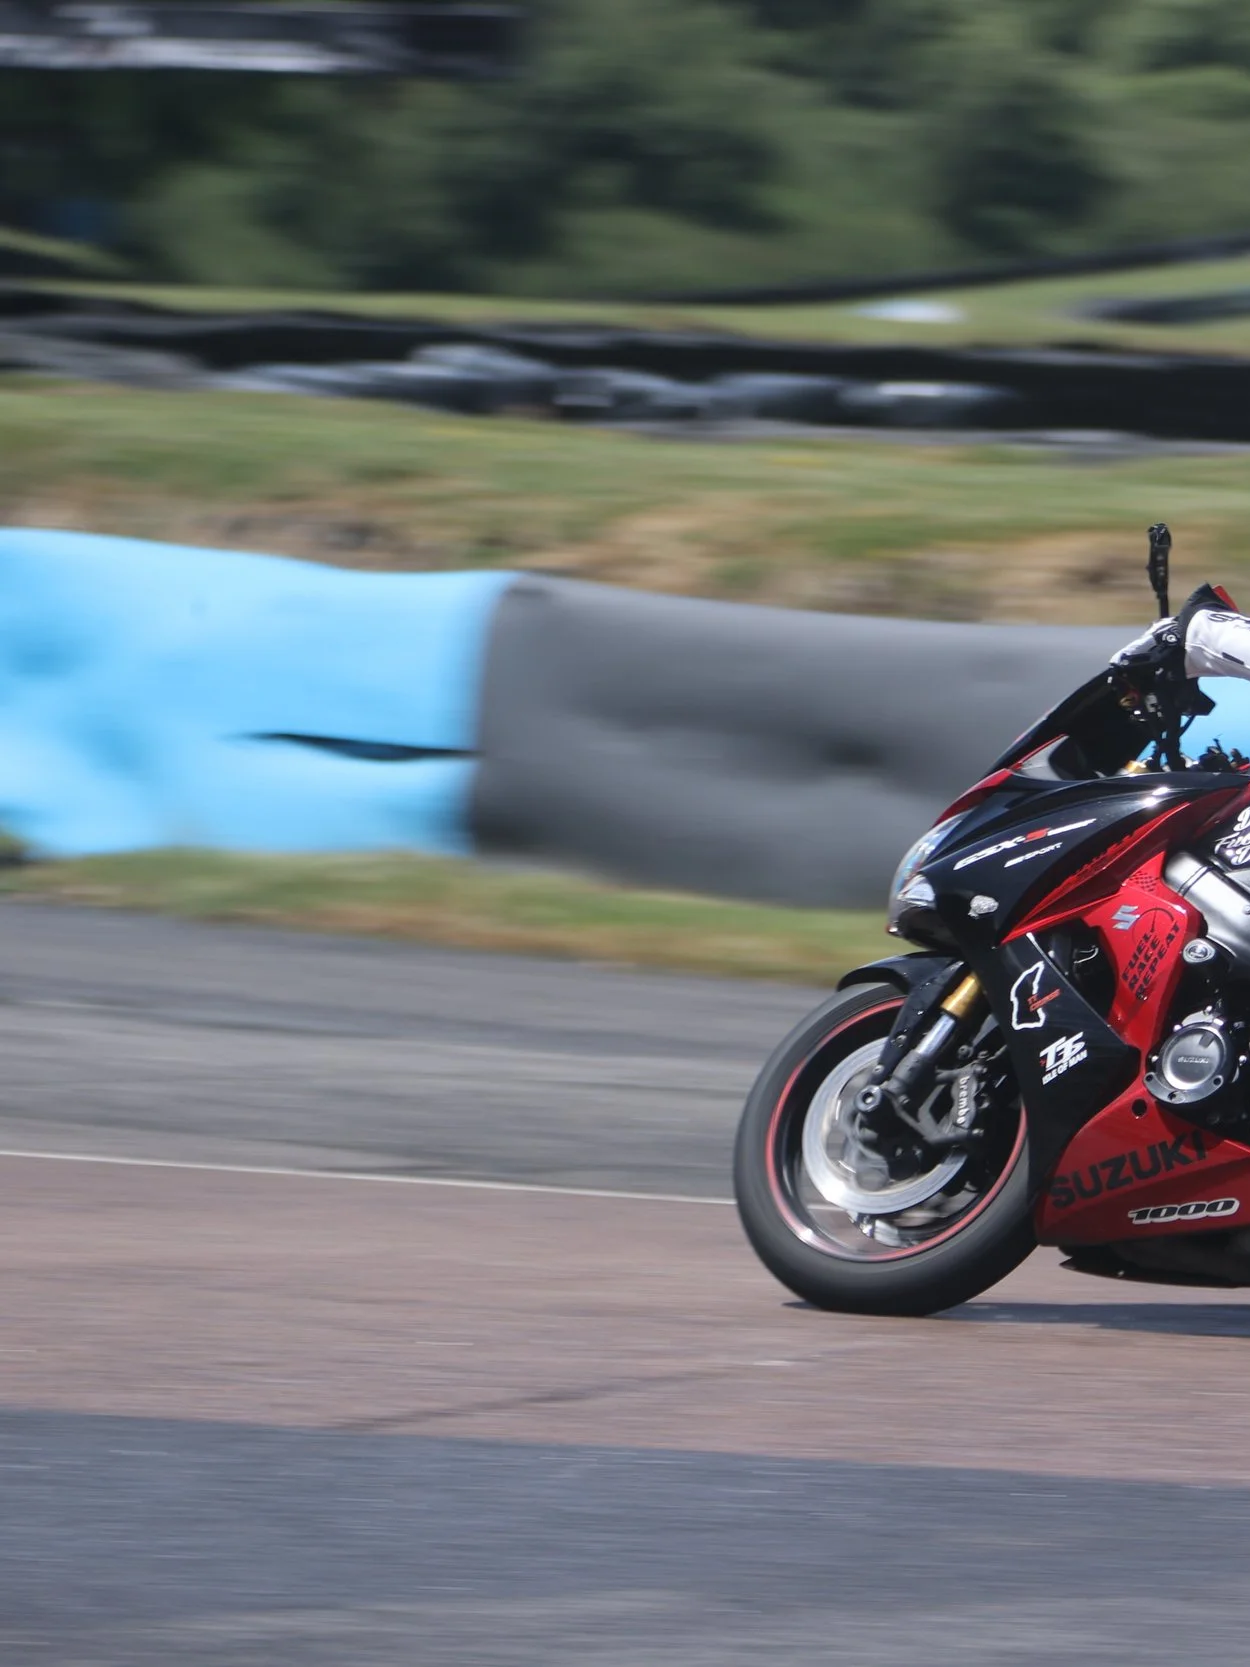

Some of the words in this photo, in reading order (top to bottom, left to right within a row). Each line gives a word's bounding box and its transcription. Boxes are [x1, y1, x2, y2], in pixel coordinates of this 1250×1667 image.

[1122, 932, 1152, 981] FUEL
[1128, 935, 1160, 990] RACE
[1136, 921, 1180, 999] REPEAT
[1042, 1068, 1058, 1085] ISLE
[1057, 1061, 1069, 1075] OF
[1069, 1050, 1088, 1068] MAN
[957, 1076, 970, 1124] brembo
[1051, 1130, 1207, 1210] SUZUKI
[1128, 1198, 1239, 1225] 1000
